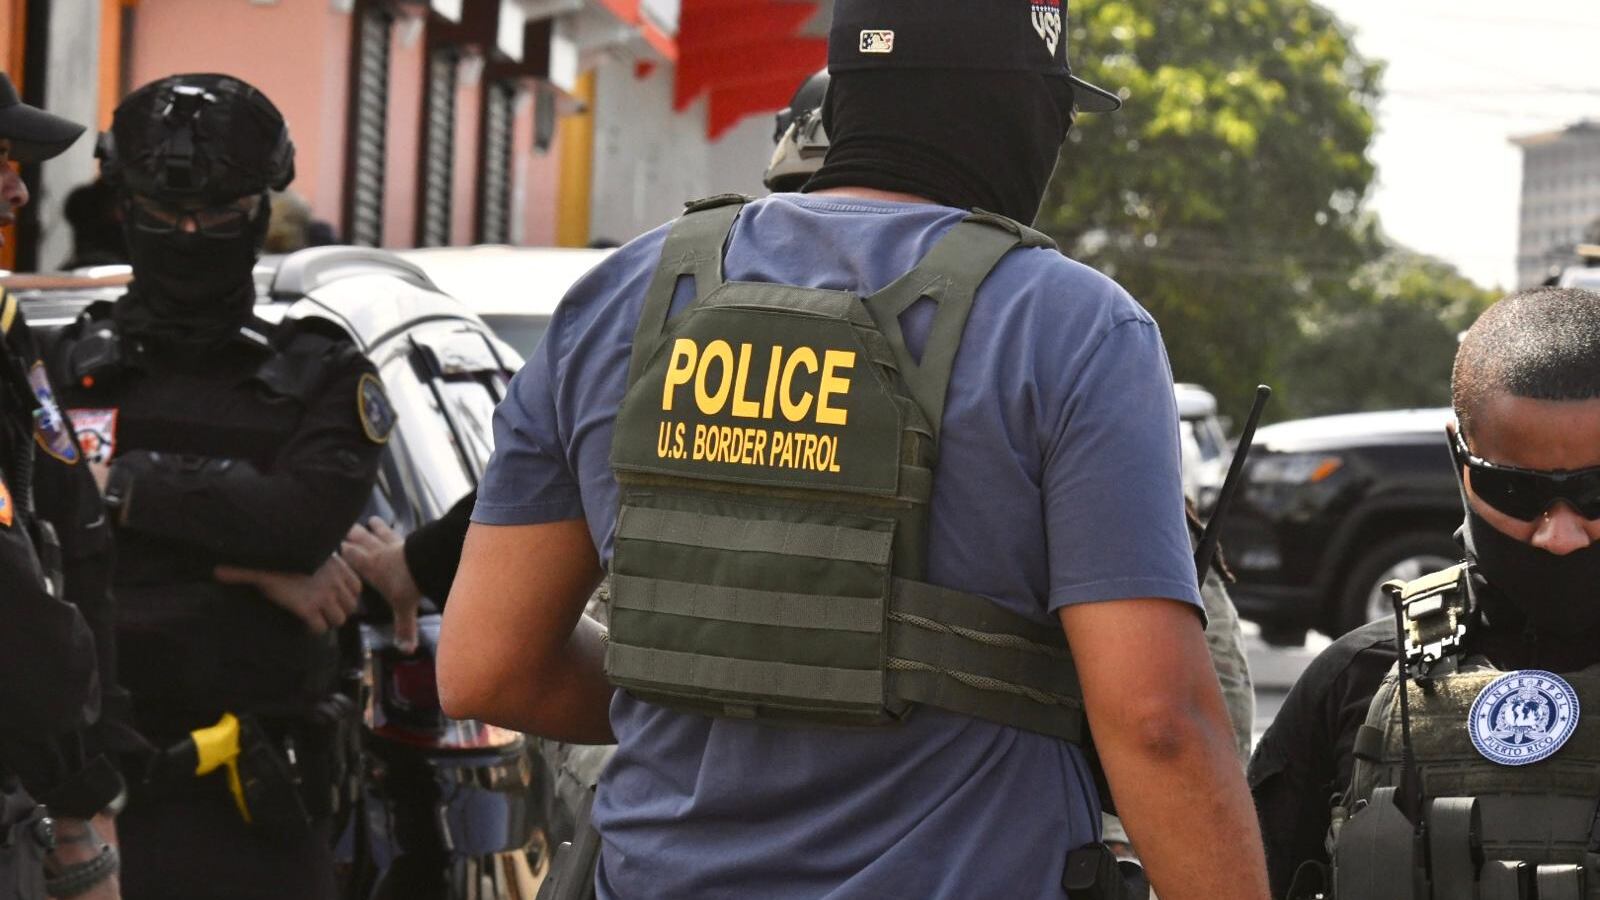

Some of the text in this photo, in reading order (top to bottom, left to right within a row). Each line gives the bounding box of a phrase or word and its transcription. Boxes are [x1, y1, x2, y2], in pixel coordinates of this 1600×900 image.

[662, 338, 856, 425] POLICE
[657, 421, 841, 472] U.S. BORDER PATROL
[1486, 679, 1568, 709] INTERPOL
[1485, 735, 1553, 756] PUERTO RICO
